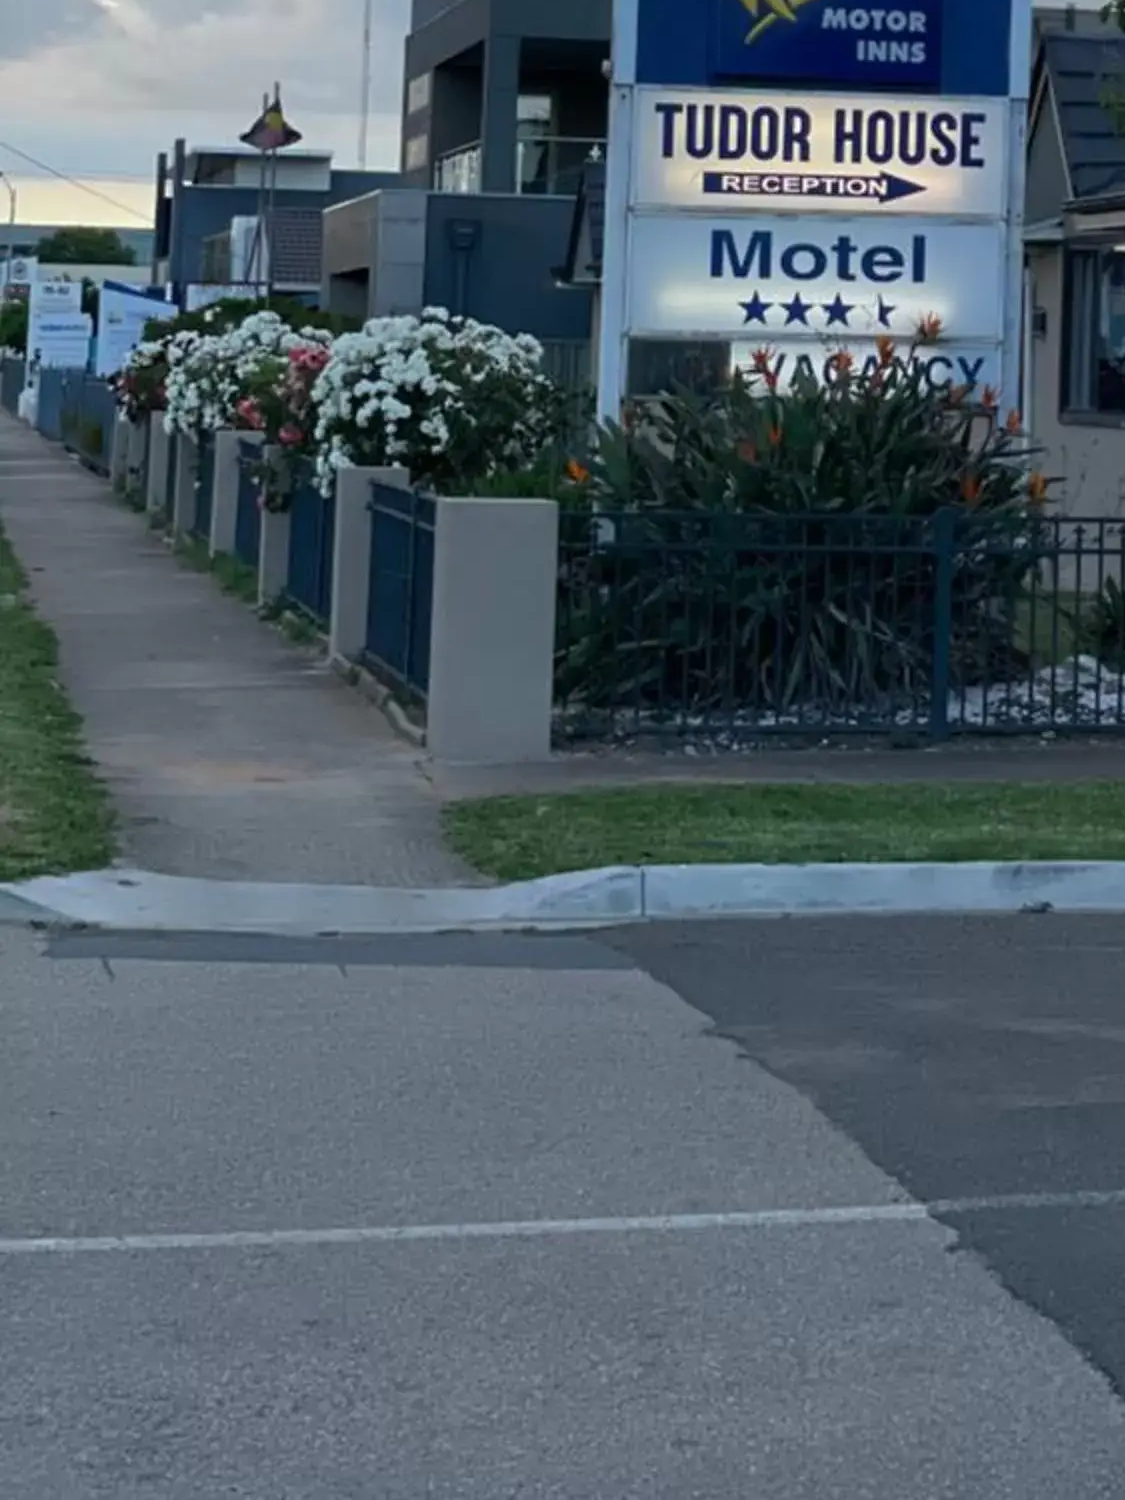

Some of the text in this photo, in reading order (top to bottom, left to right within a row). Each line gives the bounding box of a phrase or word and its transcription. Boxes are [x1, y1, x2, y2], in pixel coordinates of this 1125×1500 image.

[822, 7, 927, 33] MOTOR
[856, 40, 927, 64] INNS
[655, 103, 986, 168] TUDOR HOUSE
[721, 174, 888, 197] RECEPTION
[710, 229, 926, 284] Motel
